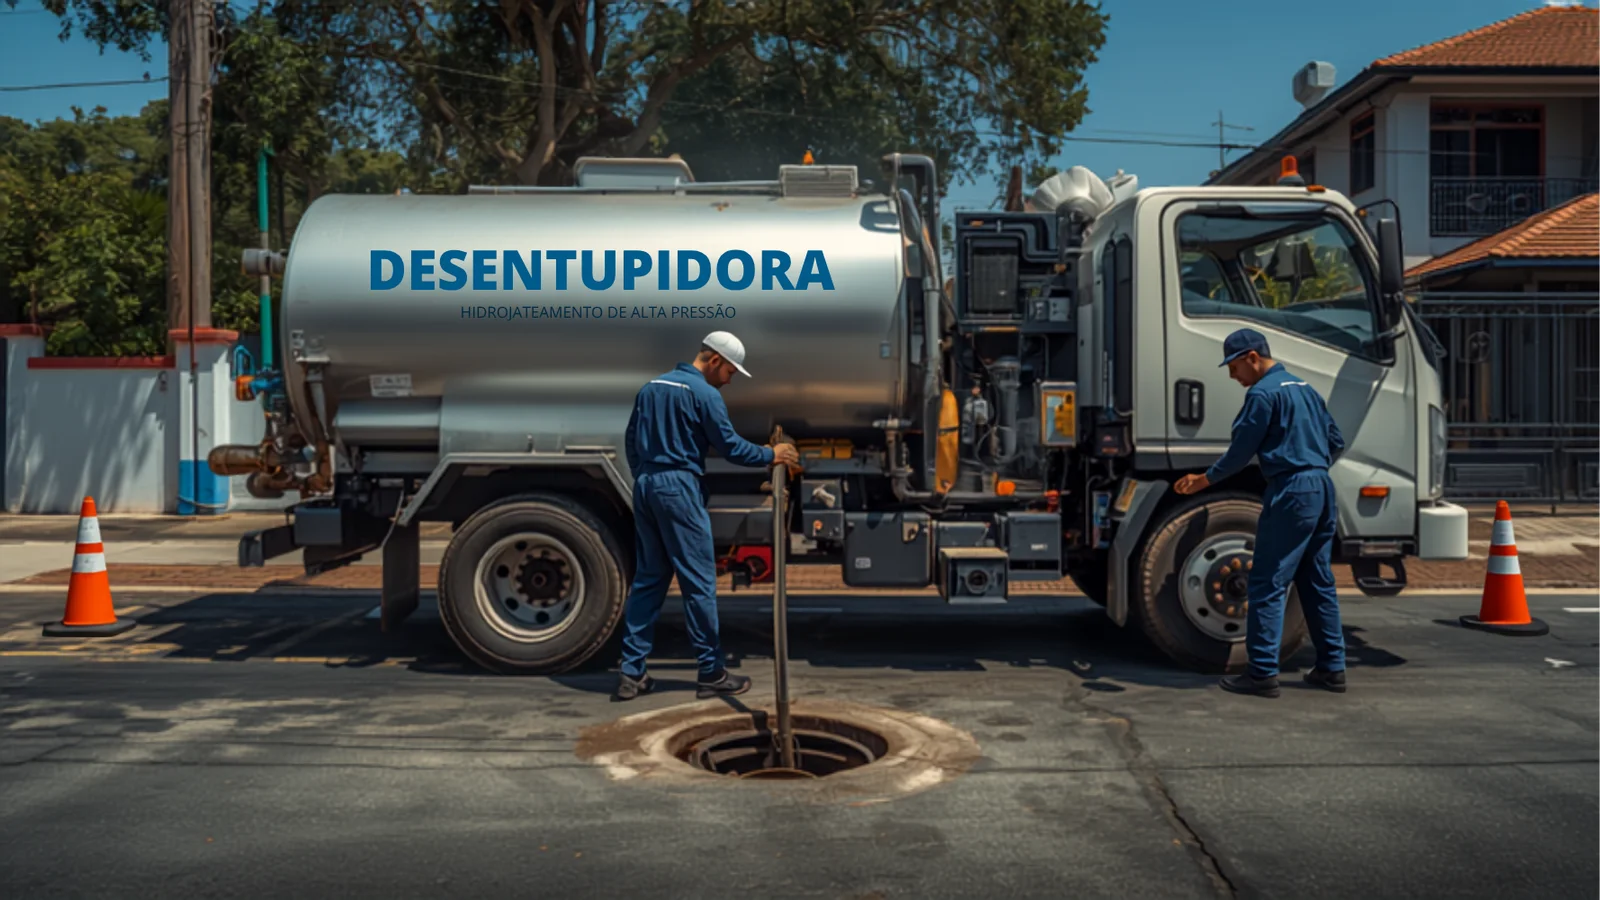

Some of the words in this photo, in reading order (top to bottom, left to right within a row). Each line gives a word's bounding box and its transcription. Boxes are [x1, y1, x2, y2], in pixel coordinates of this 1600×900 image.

[370, 249, 835, 291] DESENTUPIDORA
[461, 306, 603, 321] HIDROJATEAMENTO
[608, 306, 627, 319] DE
[630, 306, 667, 319] ALTA
[671, 304, 736, 319] PRESSÃO
